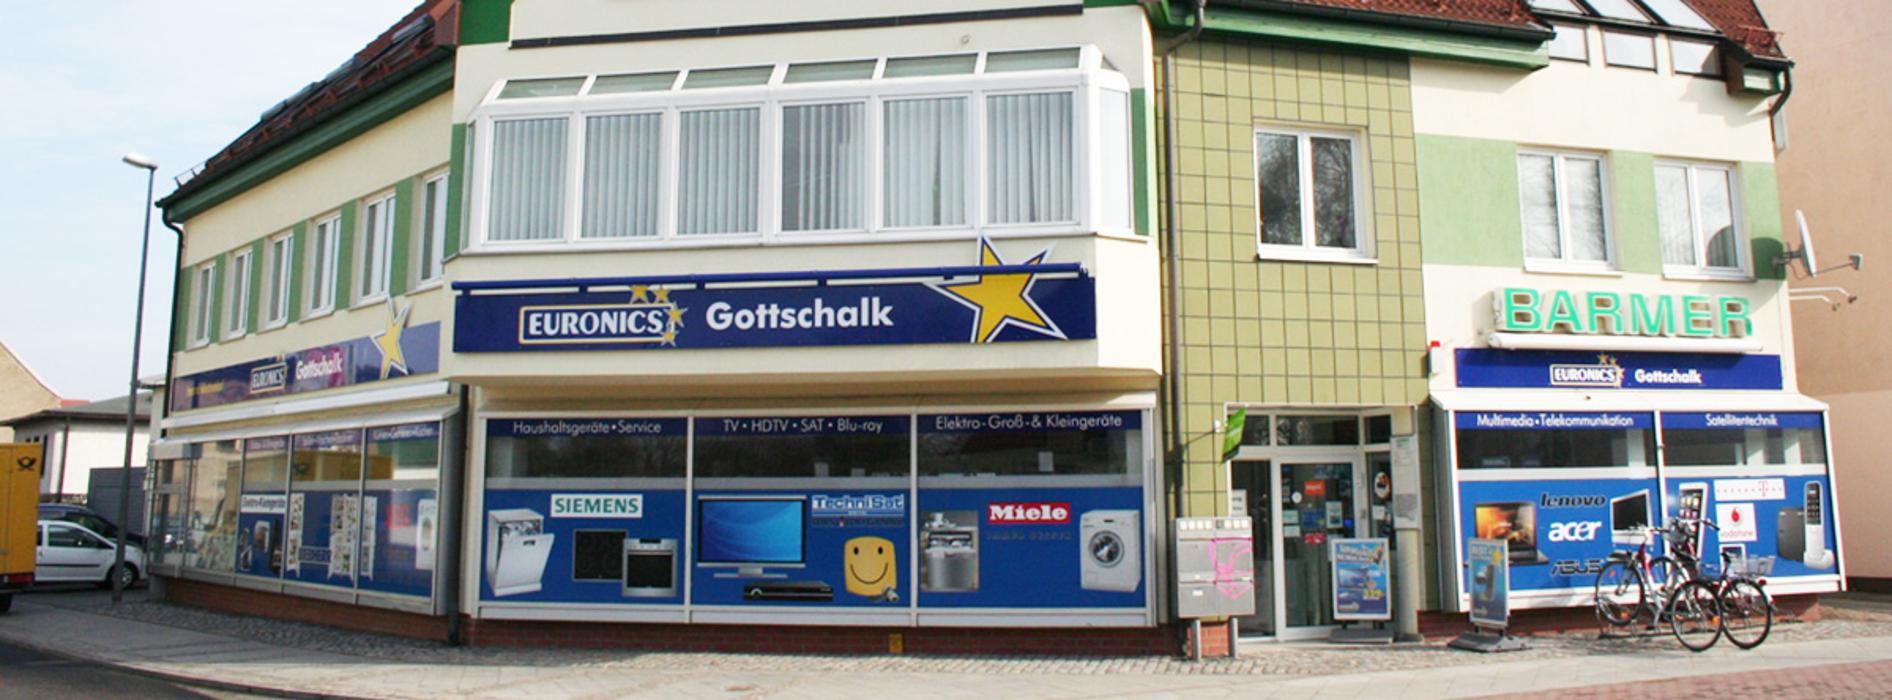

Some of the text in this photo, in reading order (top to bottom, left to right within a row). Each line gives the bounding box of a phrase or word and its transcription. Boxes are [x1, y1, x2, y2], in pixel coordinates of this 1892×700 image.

[529, 297, 894, 336] EURONICS Gottschalk
[1503, 287, 1753, 337] BARMER
[296, 352, 343, 380] Gottschalk
[1553, 368, 1702, 384] EURONICS Gottschalk
[723, 417, 883, 433] TV HDTV SAT Blu-ray
[1046, 415, 1122, 430] Kleingeräte
[1476, 413, 1633, 427] Multimedia Telekommunikation
[1705, 413, 1778, 426] Satellitentechnik
[513, 419, 662, 437] Haushaltsgeräte Service
[554, 497, 639, 513] SIEMENS
[813, 494, 904, 510] TechniSat
[1540, 493, 1606, 507] lenovo
[989, 503, 1067, 520] Miele
[1548, 520, 1602, 542] acer
